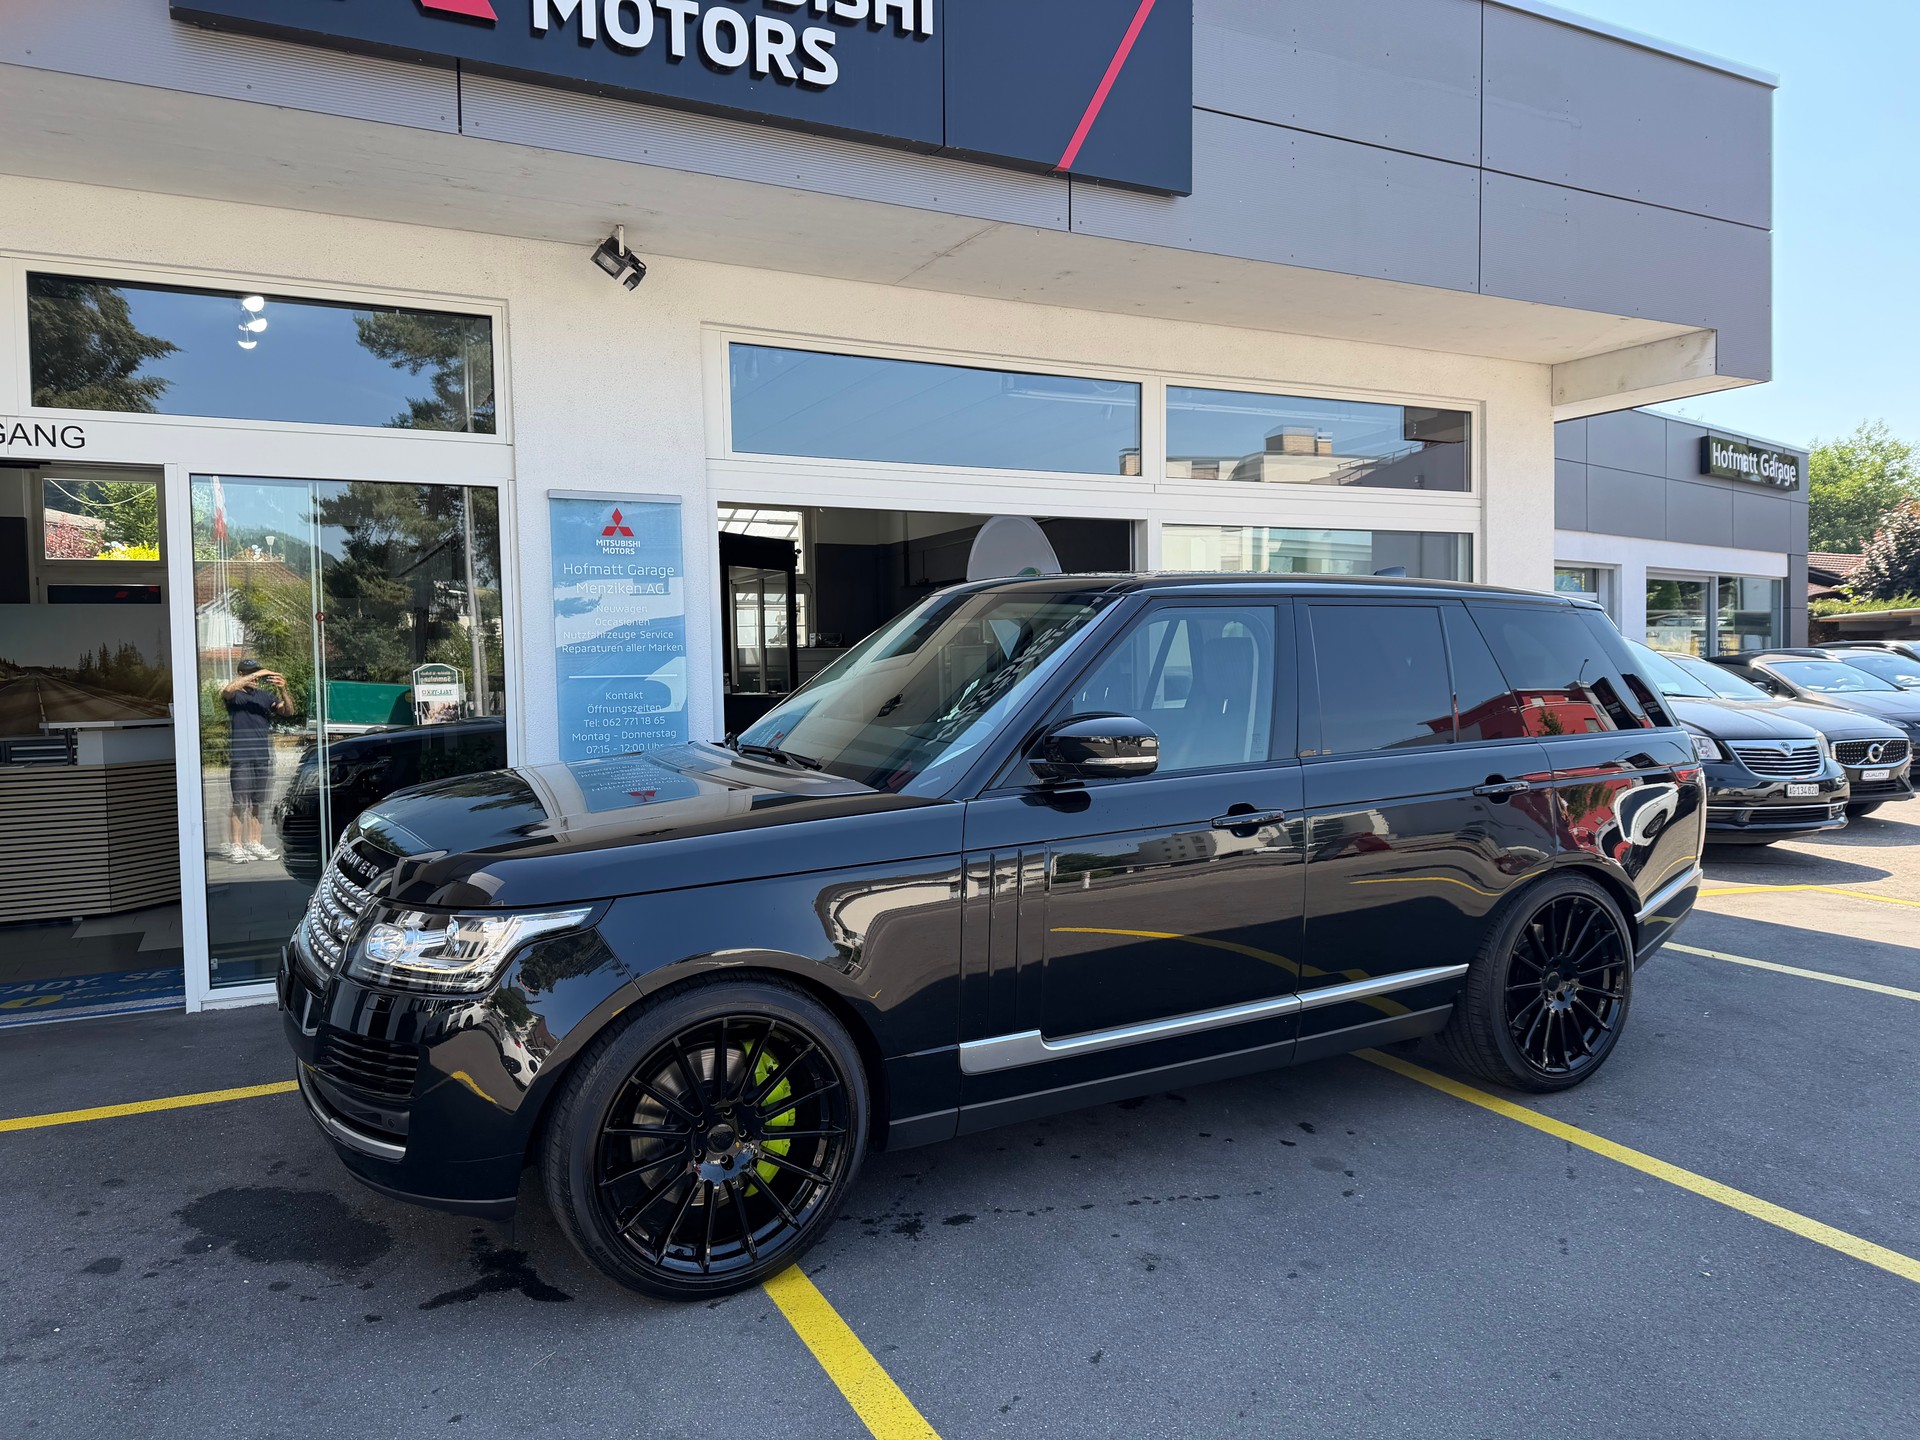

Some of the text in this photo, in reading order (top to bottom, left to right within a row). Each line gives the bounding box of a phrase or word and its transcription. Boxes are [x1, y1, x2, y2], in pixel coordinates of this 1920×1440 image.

[533, 0, 839, 86] MOTORS
[0, 422, 86, 449] ANG
[1712, 442, 1797, 486] Hofmatt Garage
[596, 539, 641, 548] MITSUBISHI
[602, 547, 636, 555] MOTORS
[563, 563, 675, 578] Hofmatt Garage
[576, 582, 665, 594] Menziken AG
[596, 605, 648, 615] Neuwagen
[595, 618, 651, 627] Occasionen
[563, 630, 674, 641] Nutzfahrzeuge Service
[562, 643, 684, 655] Reparaturen aller Marken
[605, 691, 644, 700] Kontakt
[587, 703, 662, 715] Öffnungszeiten
[584, 716, 666, 728] Tel: 062 771 18 65
[572, 732, 611, 743] Montag
[621, 729, 677, 740] Donnerstag
[586, 744, 610, 754] 07:15
[620, 743, 645, 753] 12:00
